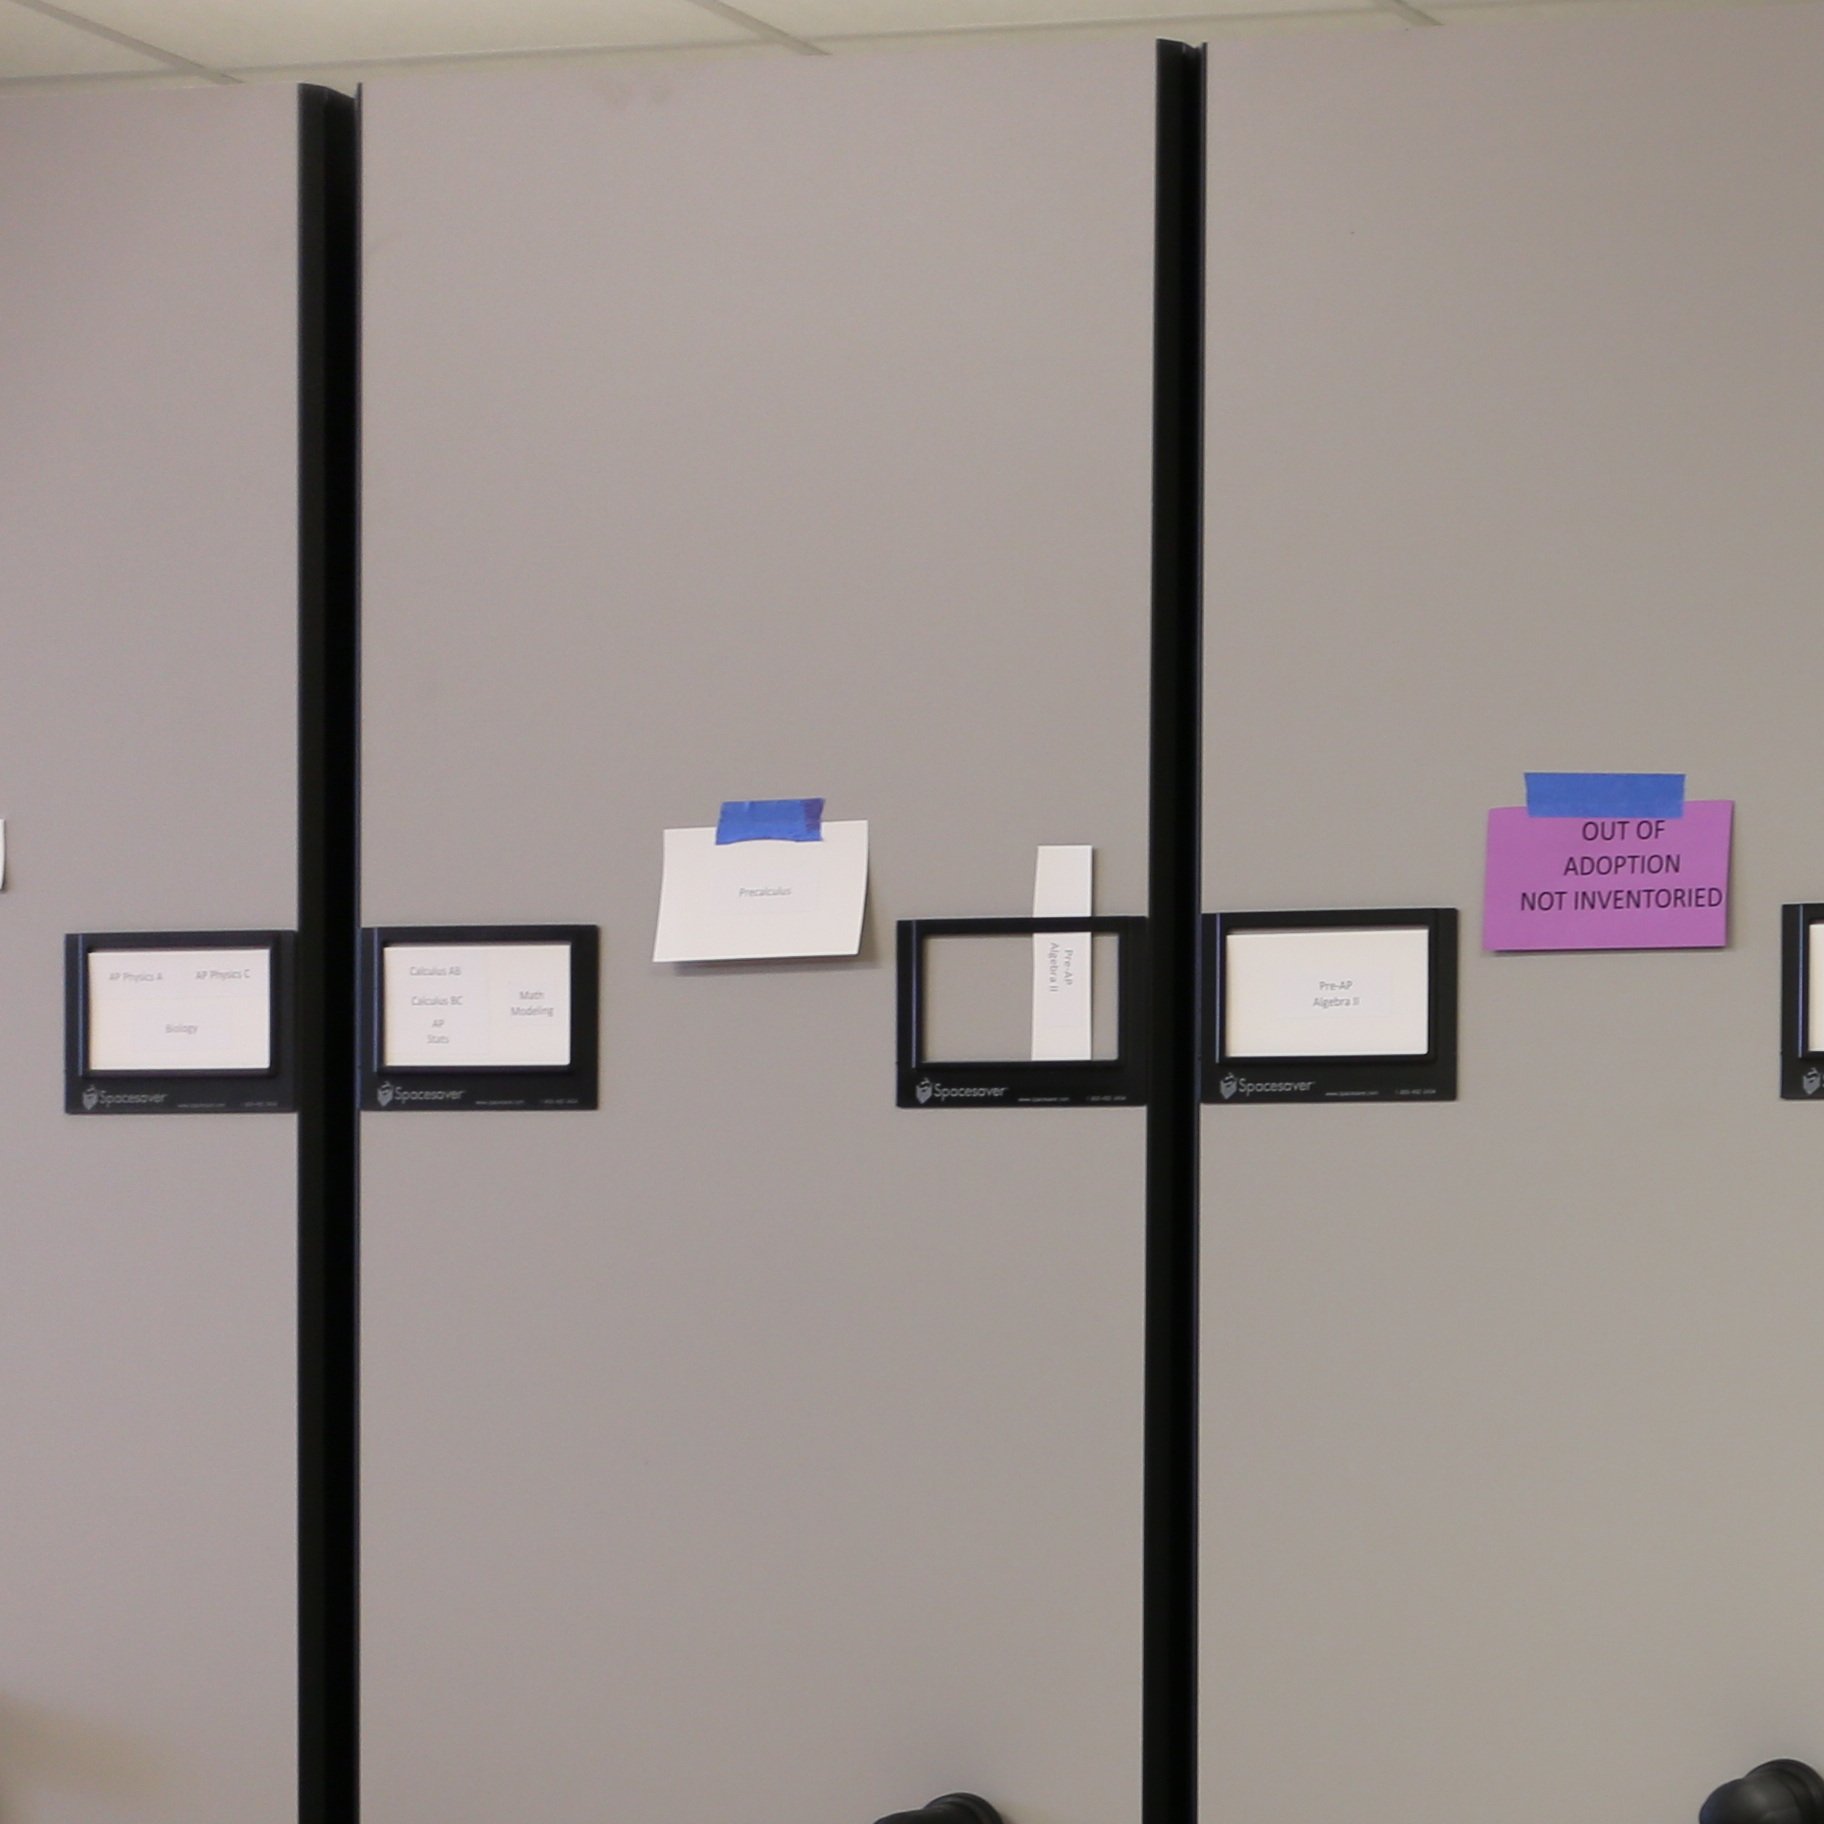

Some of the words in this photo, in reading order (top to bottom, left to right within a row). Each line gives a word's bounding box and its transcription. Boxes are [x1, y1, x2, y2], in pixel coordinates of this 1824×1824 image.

[1582, 820, 1630, 841] OUT
[1636, 819, 1666, 840] OF
[1563, 853, 1681, 876] ADOPTION
[738, 886, 792, 898] Precalculus
[1520, 890, 1568, 912] NOT
[1573, 887, 1724, 911] INVENTORIED
[1048, 942, 1060, 983] Algebra
[1064, 949, 1074, 986] Pre-AP
[1319, 980, 1353, 991] Pre-AP
[519, 991, 544, 1000] Math
[1313, 997, 1351, 1009] Algebra
[511, 1006, 554, 1017] Modeling
[165, 1024, 199, 1035] Biology
[427, 1034, 450, 1044] Stats
[395, 1086, 464, 1105] Spacesaver
[934, 1082, 1007, 1102] Spacesaver
[1238, 1078, 1314, 1097] Spacesaver
[99, 1089, 168, 1108] Spacesaver
